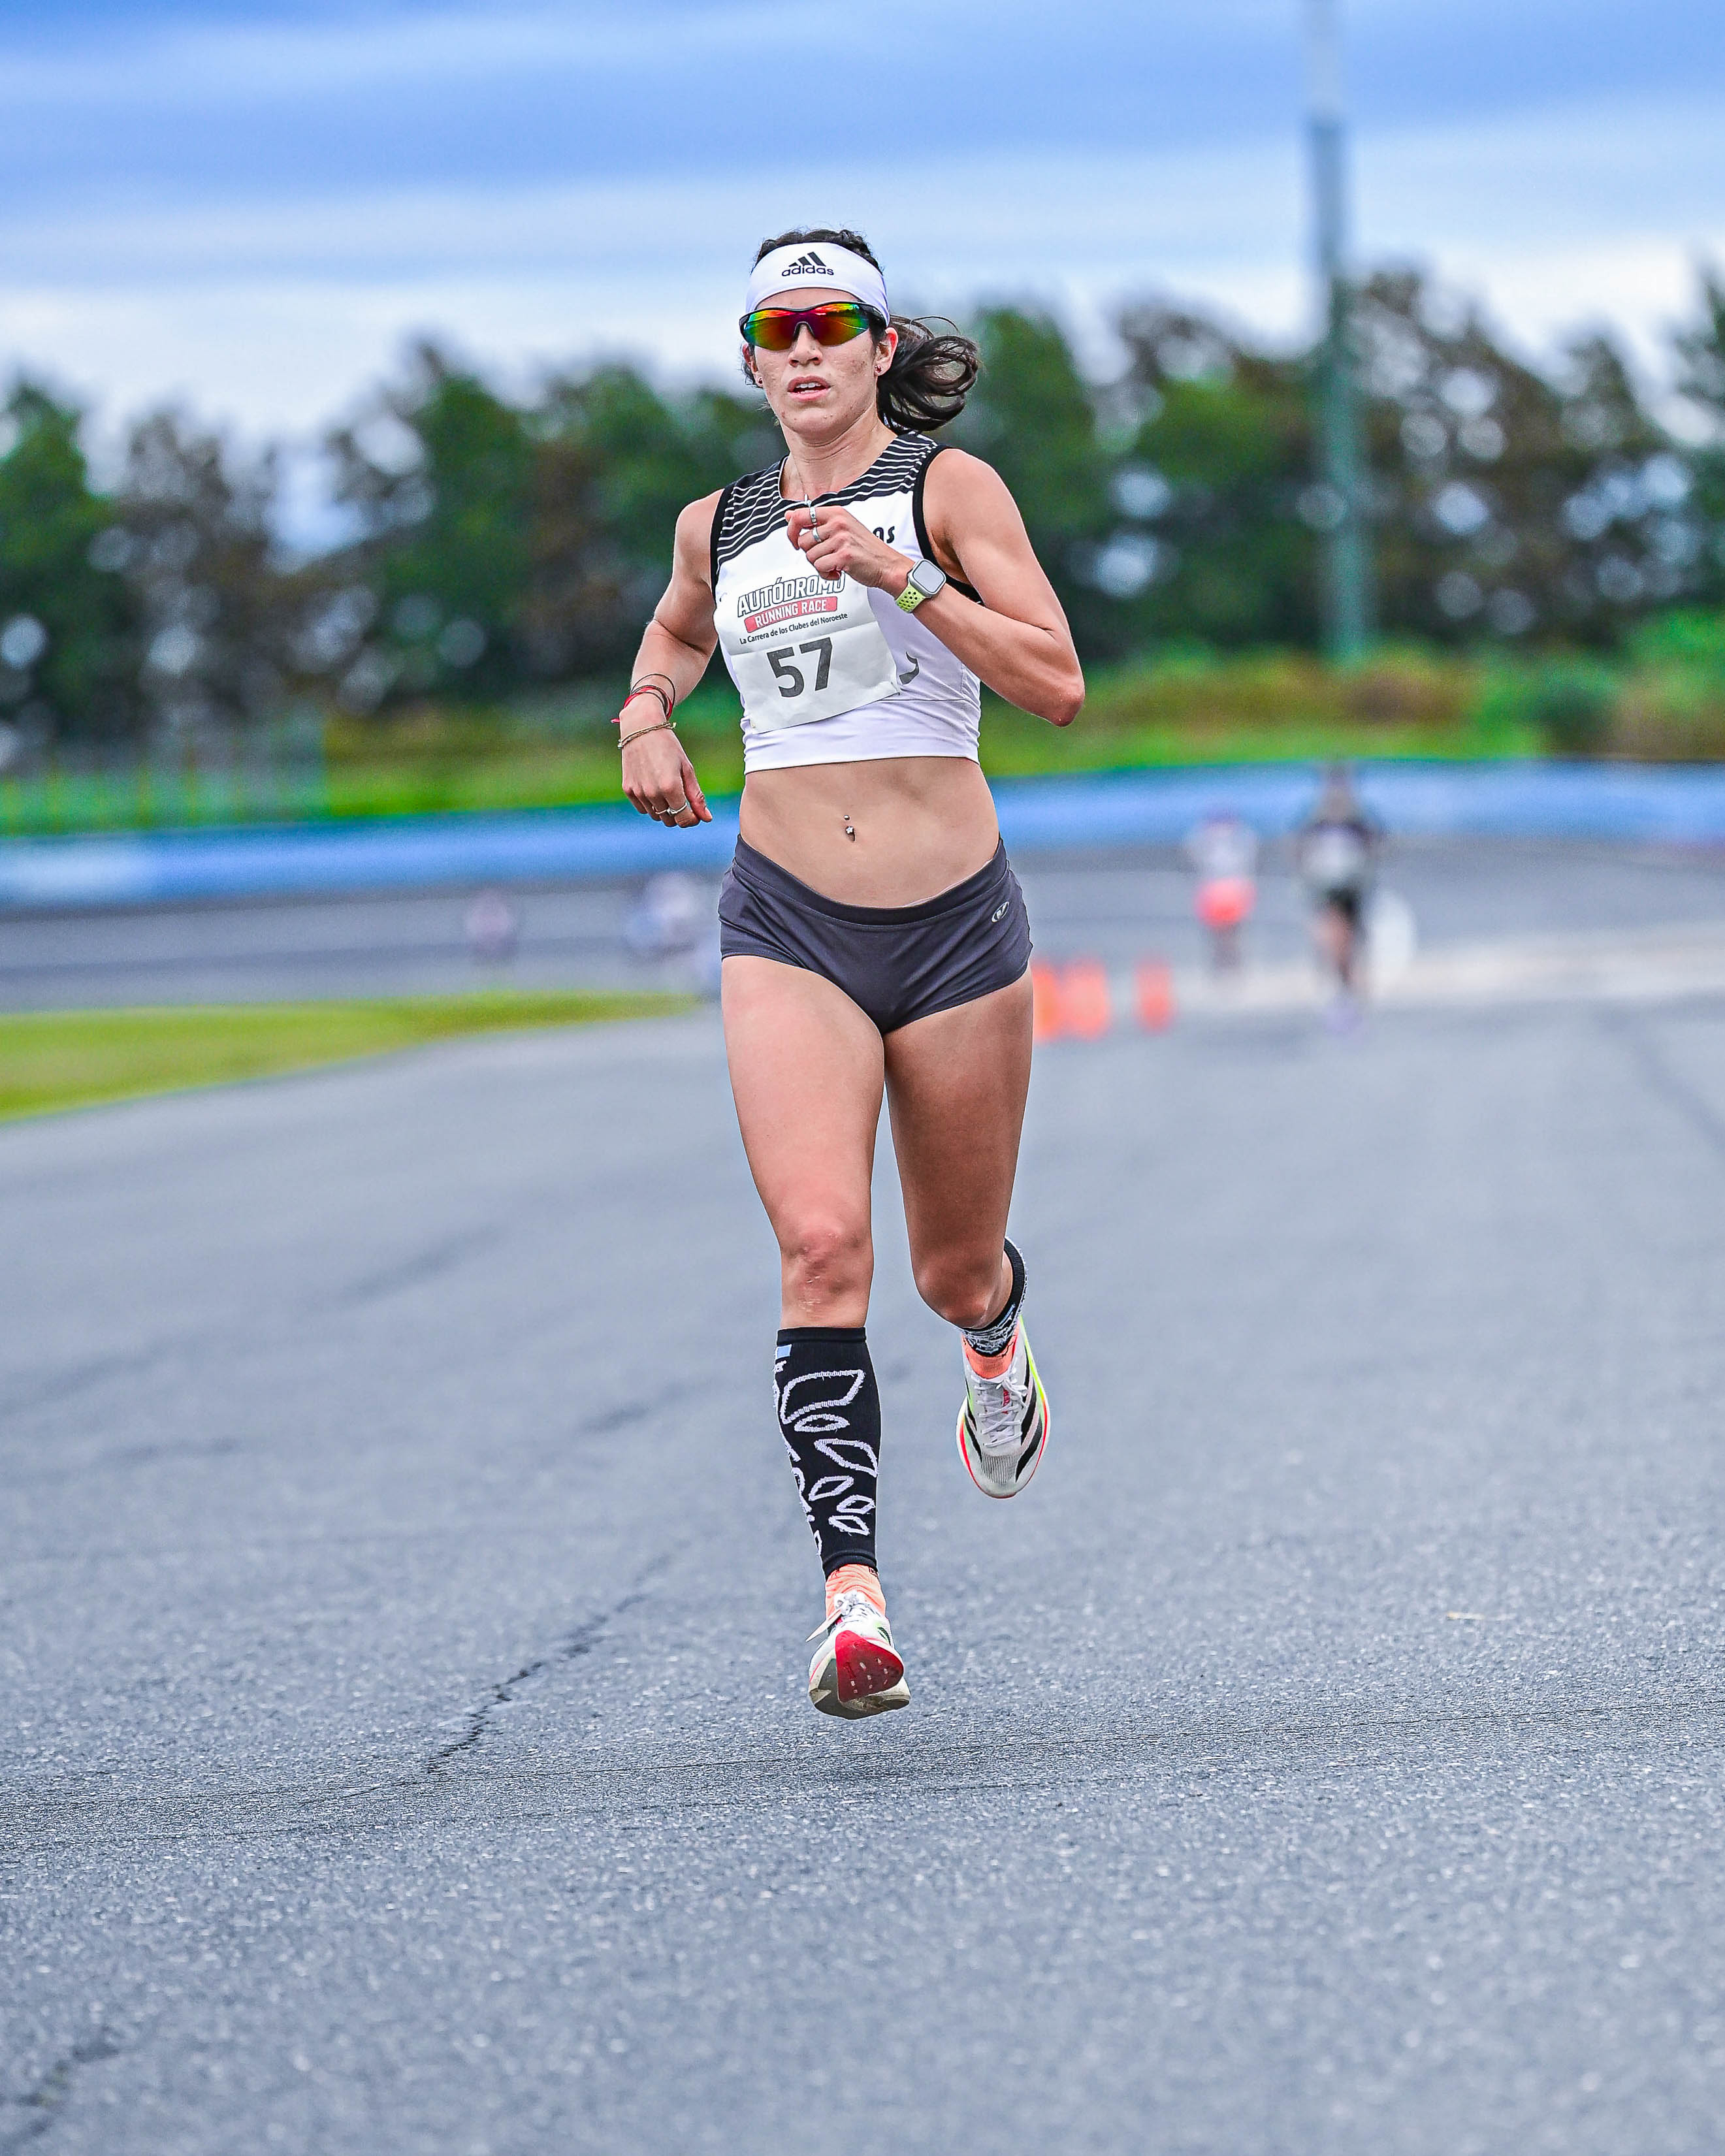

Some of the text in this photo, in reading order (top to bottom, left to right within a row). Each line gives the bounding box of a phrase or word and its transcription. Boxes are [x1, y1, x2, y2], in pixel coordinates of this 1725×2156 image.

[782, 265, 834, 277] adidas
[737, 572, 846, 618] AUTÓDROMO
[747, 632, 769, 643] Carrera
[789, 622, 809, 632] Clubes
[820, 613, 848, 624] Noroeste
[754, 599, 828, 628] RUNNING RACE
[766, 637, 833, 698] 57
